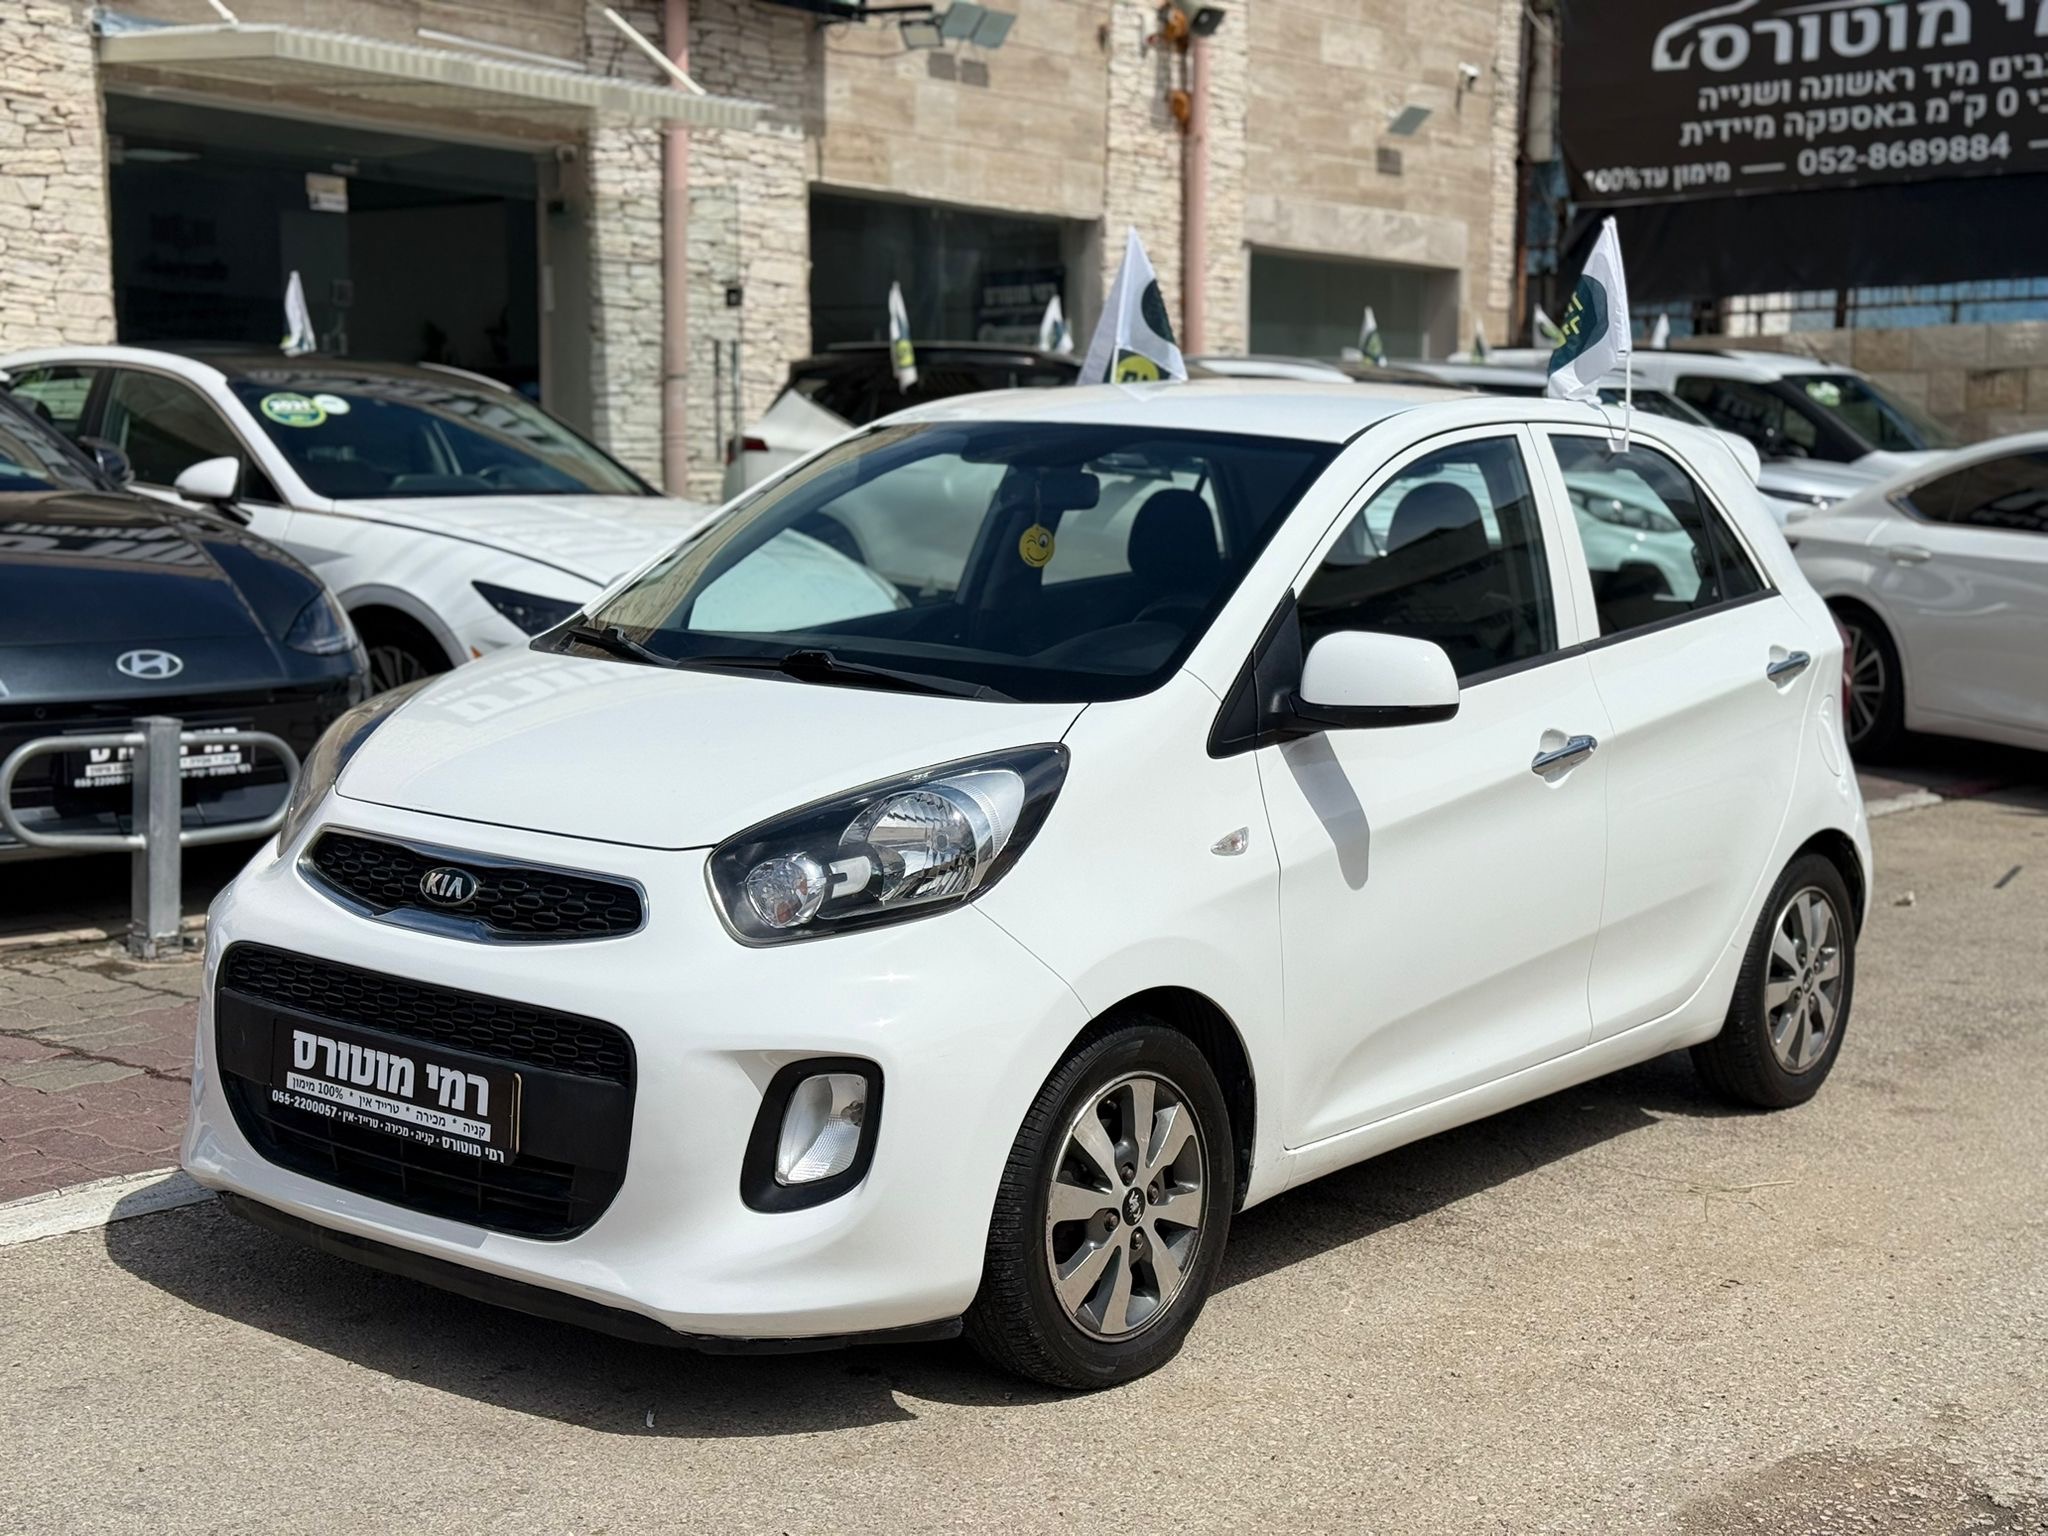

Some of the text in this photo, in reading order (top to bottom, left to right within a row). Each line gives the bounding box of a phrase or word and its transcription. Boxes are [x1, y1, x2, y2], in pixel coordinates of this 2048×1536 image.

[1698, 0, 1971, 71] מוטורס
[1698, 52, 2048, 112] בים מיד ראשונה ושנייה
[1996, 86, 2019, 118] 0
[1678, 114, 1776, 147] מיידית
[1783, 101, 1917, 142] באספקה
[1672, 161, 1731, 191] מימון
[1797, 131, 2012, 176] 052-8689884
[425, 872, 463, 899] KIA
[293, 1029, 489, 1117] רמי מוטורס
[272, 1089, 504, 1163] רמי מוטורס קניה מכירה טרייד-אין 055-2200057
[292, 1077, 486, 1138] קניה מכירה טרייד אין 100% מימון
